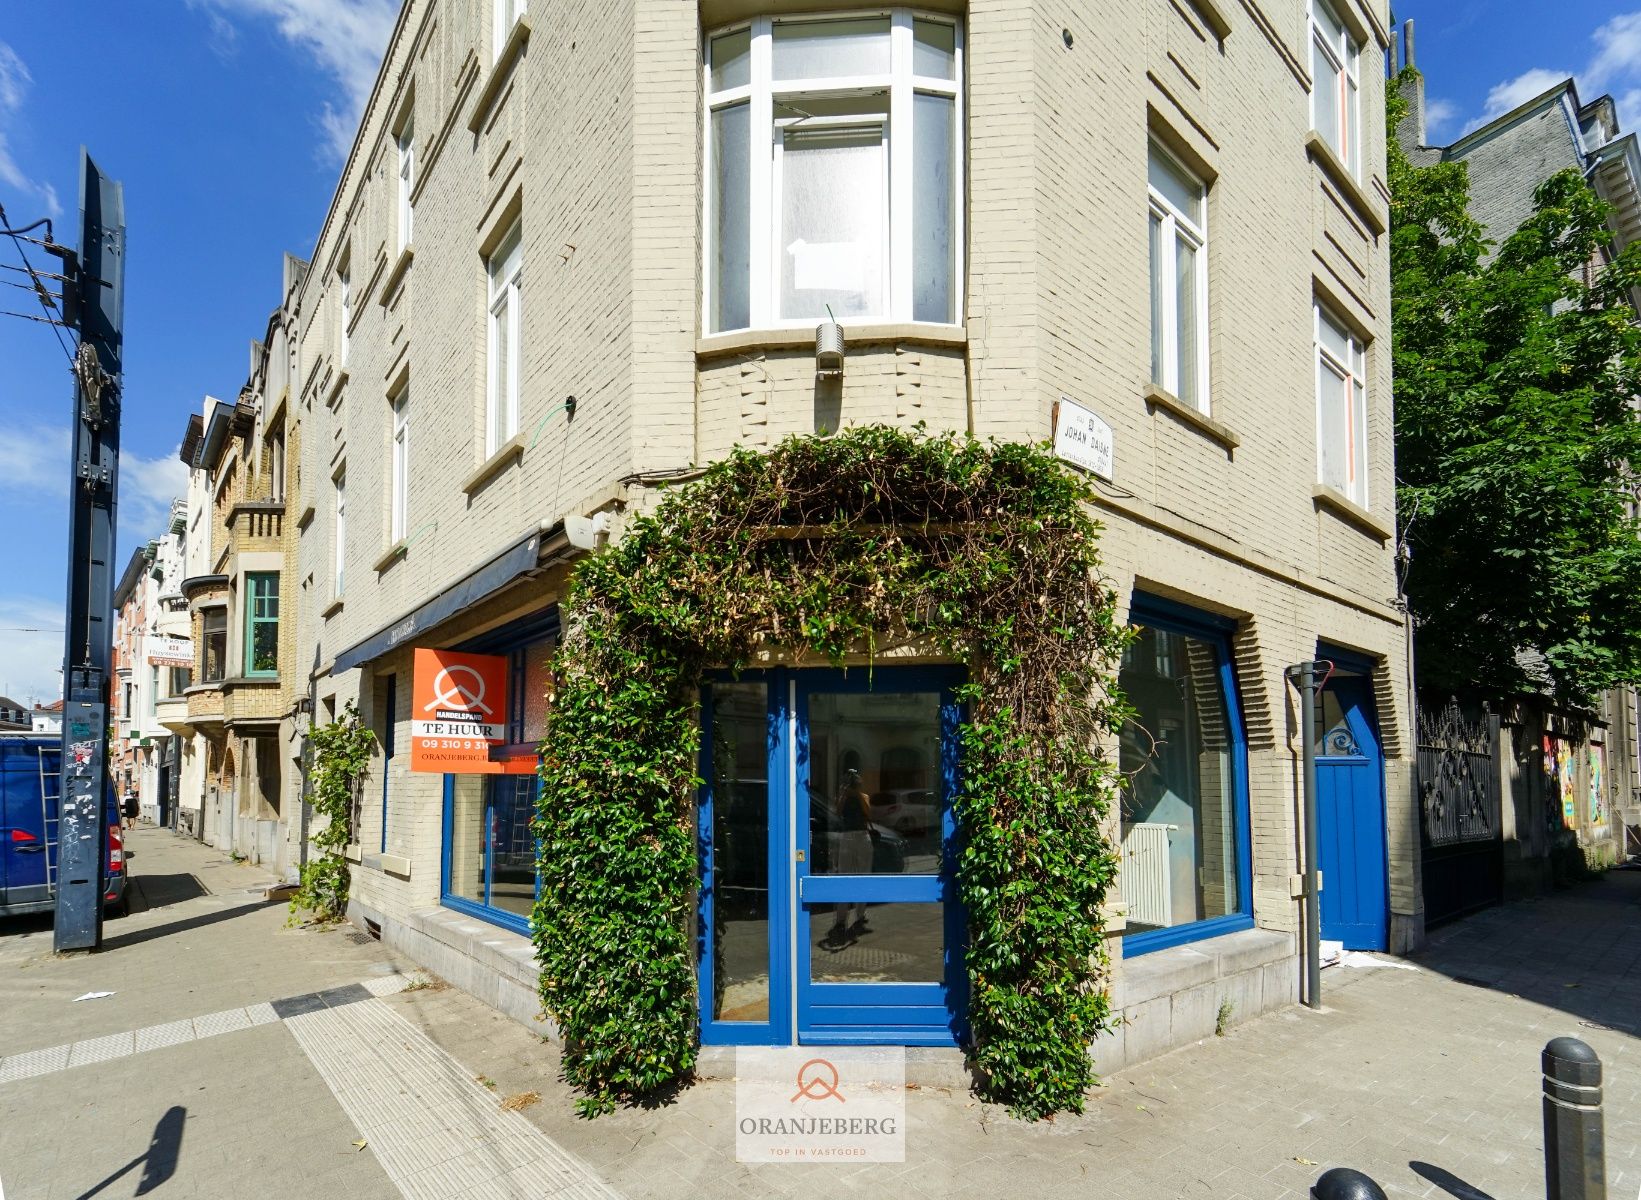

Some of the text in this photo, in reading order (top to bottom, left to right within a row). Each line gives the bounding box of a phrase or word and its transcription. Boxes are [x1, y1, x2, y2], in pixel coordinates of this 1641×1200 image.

[1065, 425, 1087, 444] JOHAN
[436, 711, 483, 722] HANDELSPAND
[422, 723, 493, 737] TE HUUR
[421, 739, 438, 749] 09
[441, 740, 461, 749] 310
[463, 740, 472, 750] 9
[421, 753, 488, 762] ORANJEBERG.B
